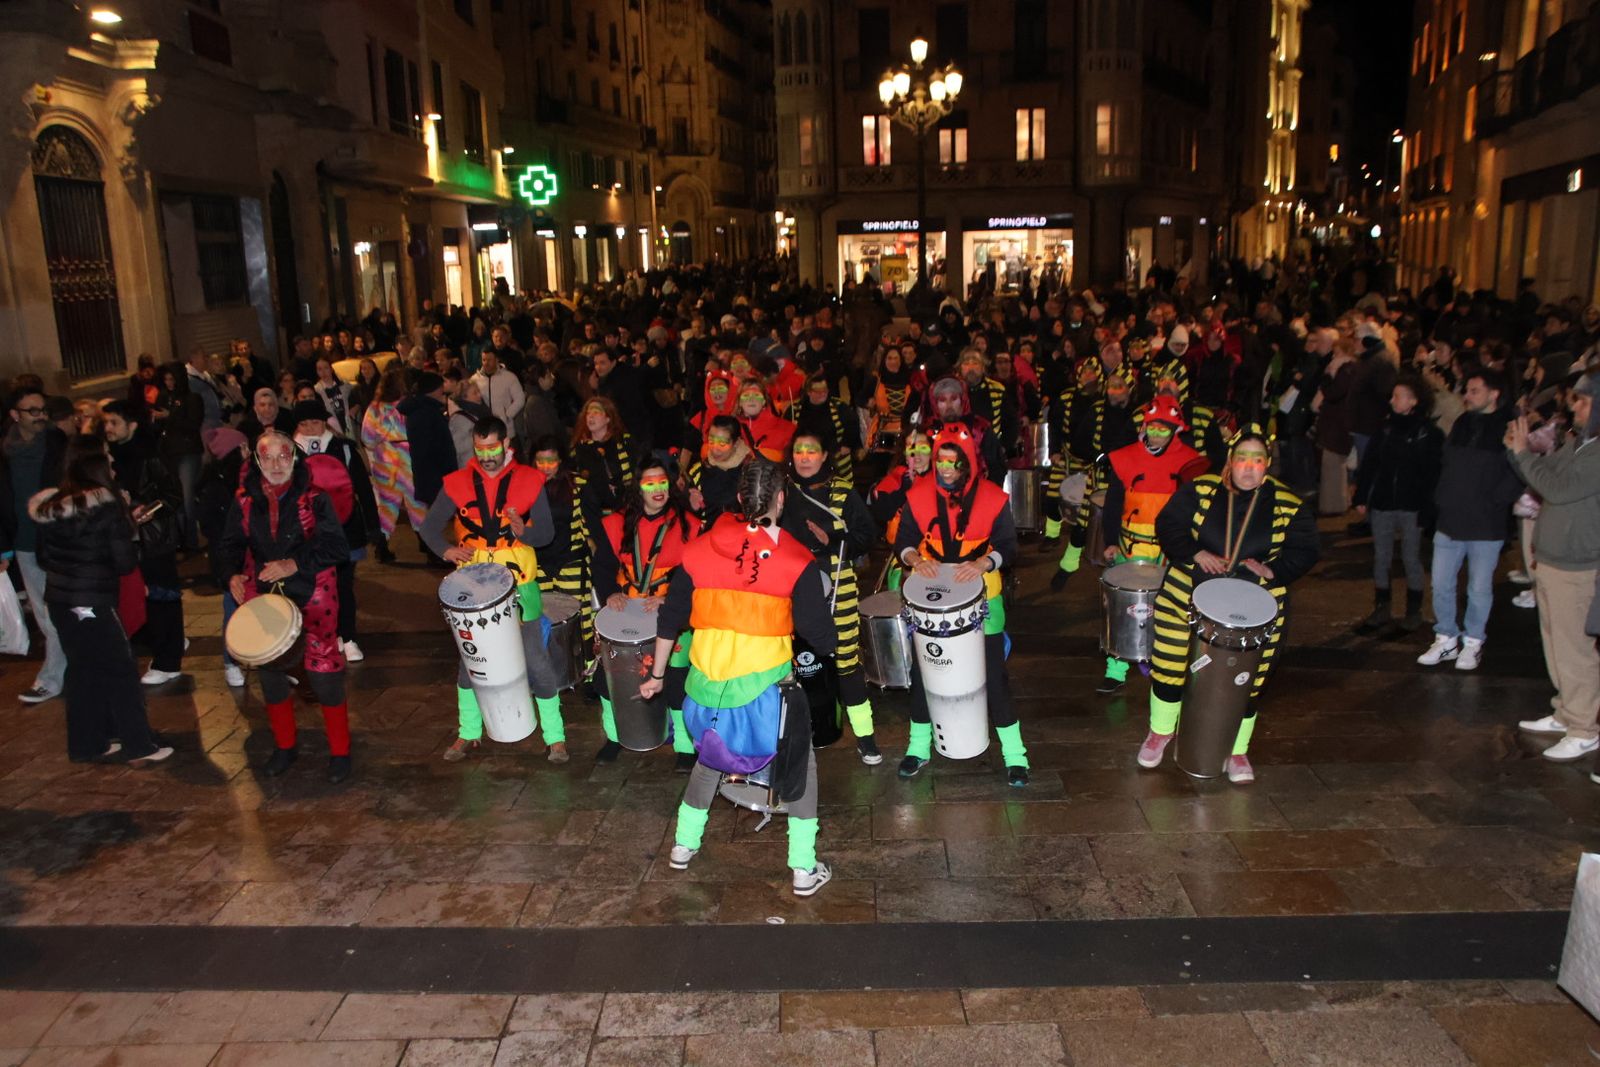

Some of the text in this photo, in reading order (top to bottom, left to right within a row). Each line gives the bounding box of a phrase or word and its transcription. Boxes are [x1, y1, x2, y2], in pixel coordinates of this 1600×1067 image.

[862, 220, 920, 231] SPRINGFIELD
[988, 216, 1047, 228] SPRINGFIELD
[923, 655, 953, 666] TIMBRA
[797, 662, 823, 673] IMBRA
